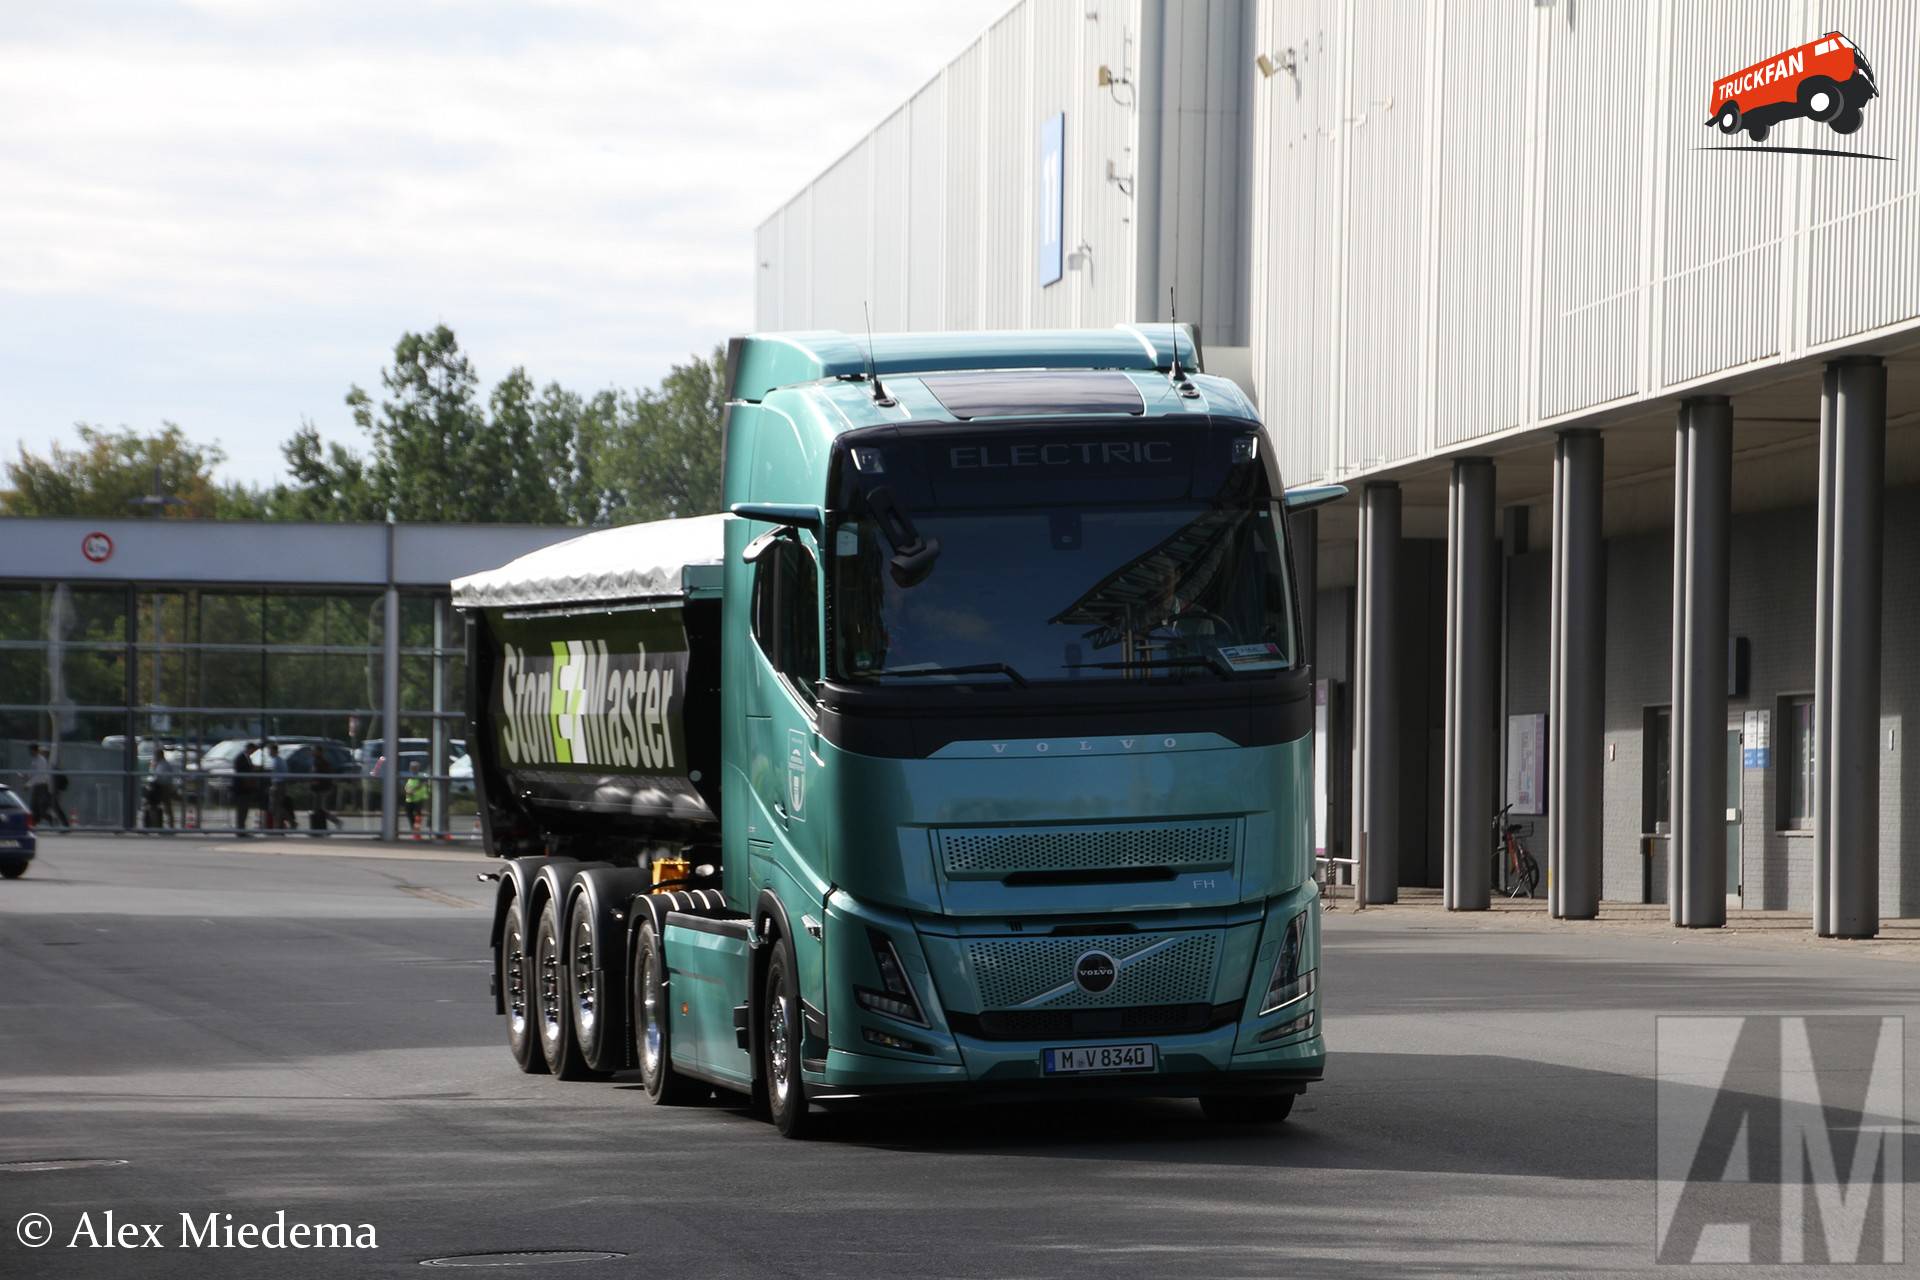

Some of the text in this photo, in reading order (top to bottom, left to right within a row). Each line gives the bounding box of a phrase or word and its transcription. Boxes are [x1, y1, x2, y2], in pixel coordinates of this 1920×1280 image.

[950, 441, 1172, 469] ELECTRIC
[992, 737, 1176, 753] VOLVO
[1193, 879, 1215, 889] FH
